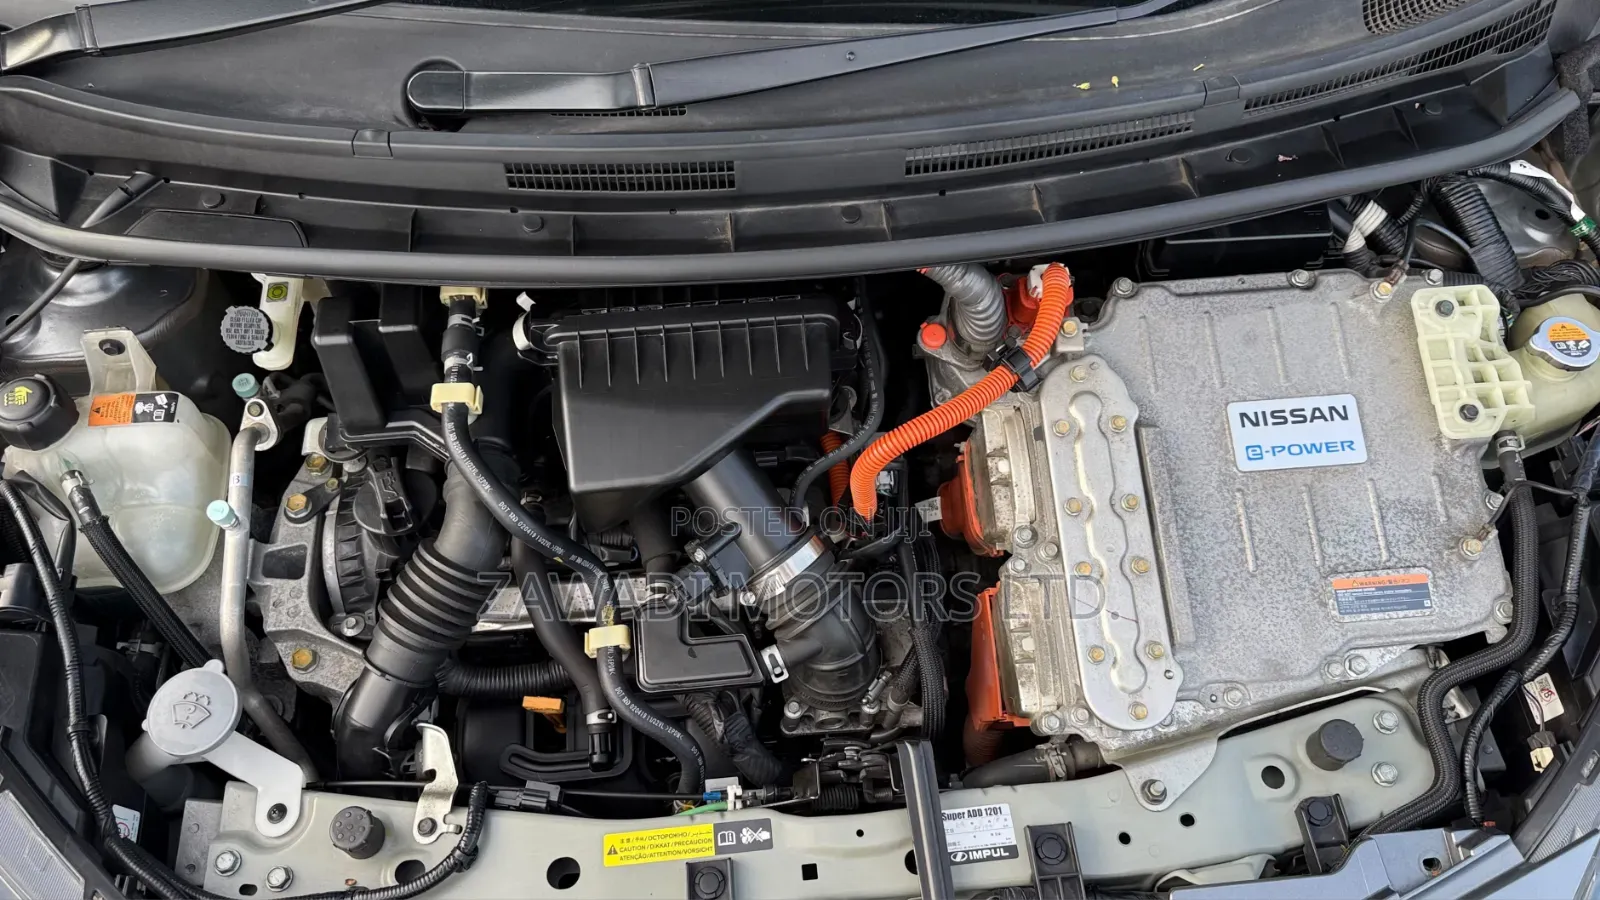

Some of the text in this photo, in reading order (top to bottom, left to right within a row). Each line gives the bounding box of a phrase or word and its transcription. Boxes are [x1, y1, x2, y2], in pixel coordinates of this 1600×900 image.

[1239, 405, 1349, 428] NISSAN
[498, 501, 510, 512] DOT
[942, 806, 1002, 821] Super ADD 1201
[968, 848, 1010, 860] IMPUL
